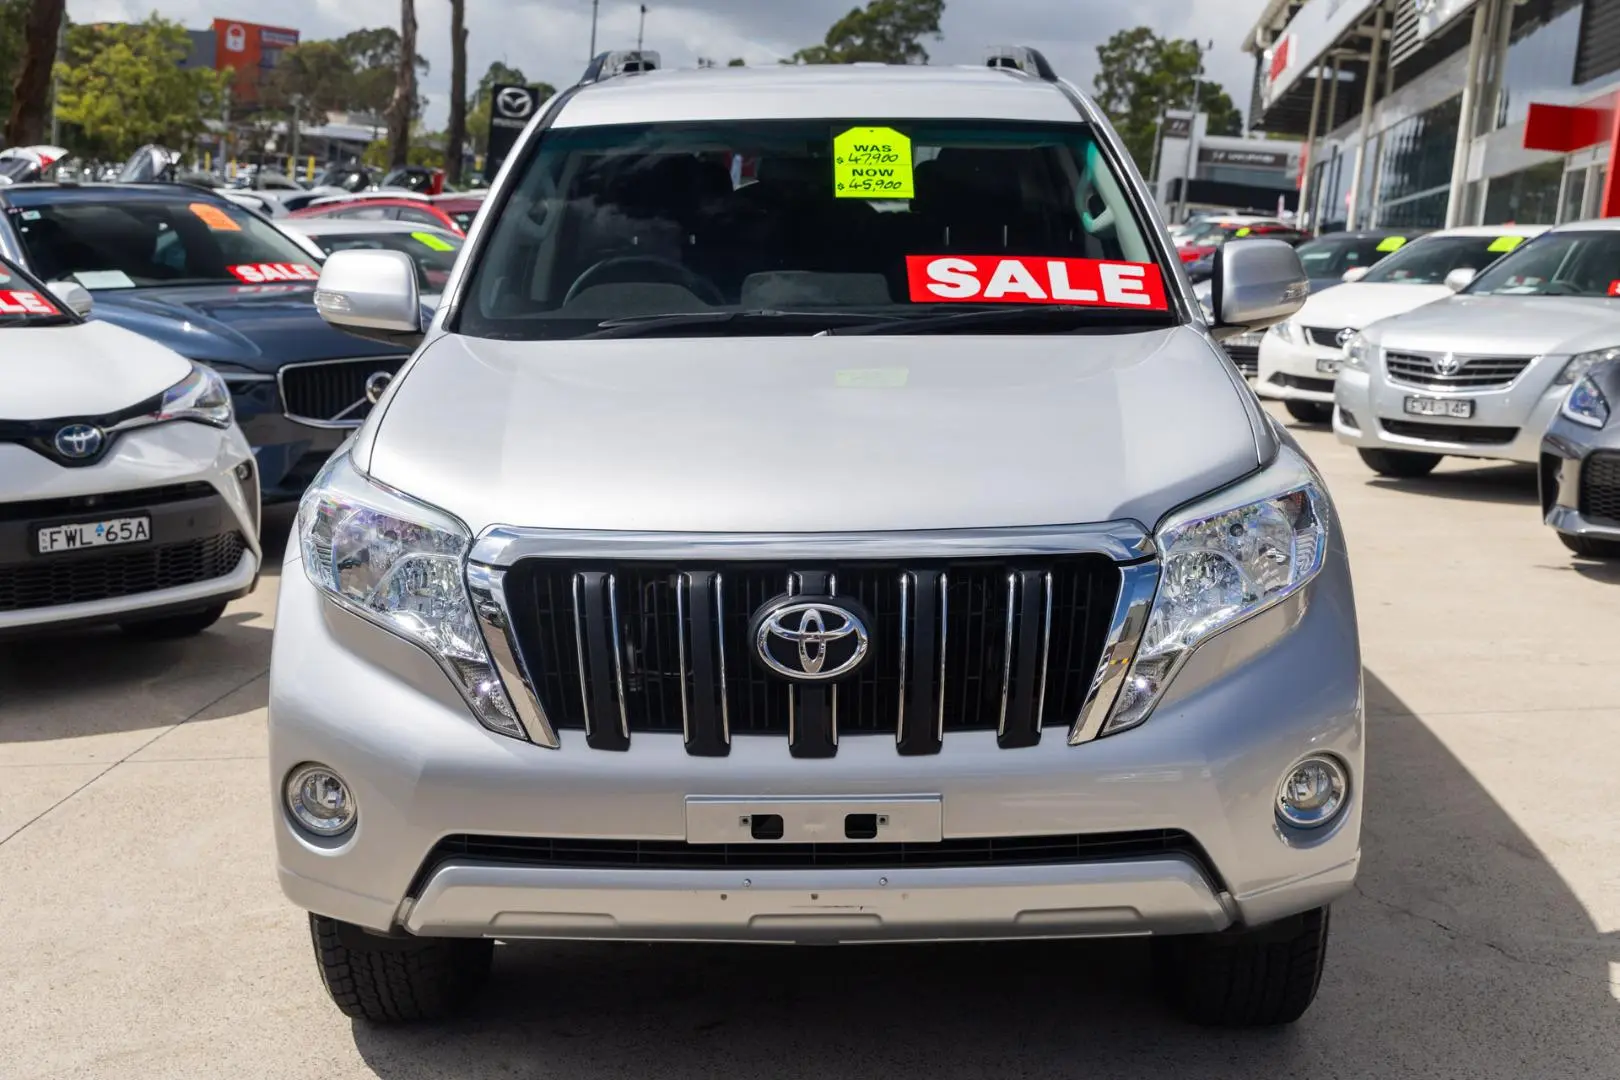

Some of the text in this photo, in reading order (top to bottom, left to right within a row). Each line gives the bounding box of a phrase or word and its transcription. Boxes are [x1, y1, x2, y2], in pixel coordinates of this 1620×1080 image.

[853, 144, 892, 152] WAS
[848, 153, 899, 165] 47,900
[852, 168, 894, 177] NOW
[849, 178, 902, 192] 45,900
[235, 263, 319, 282] SALE
[926, 257, 1152, 306] SALE
[0, 290, 54, 313] LE
[50, 520, 147, 550] FWL 65A
